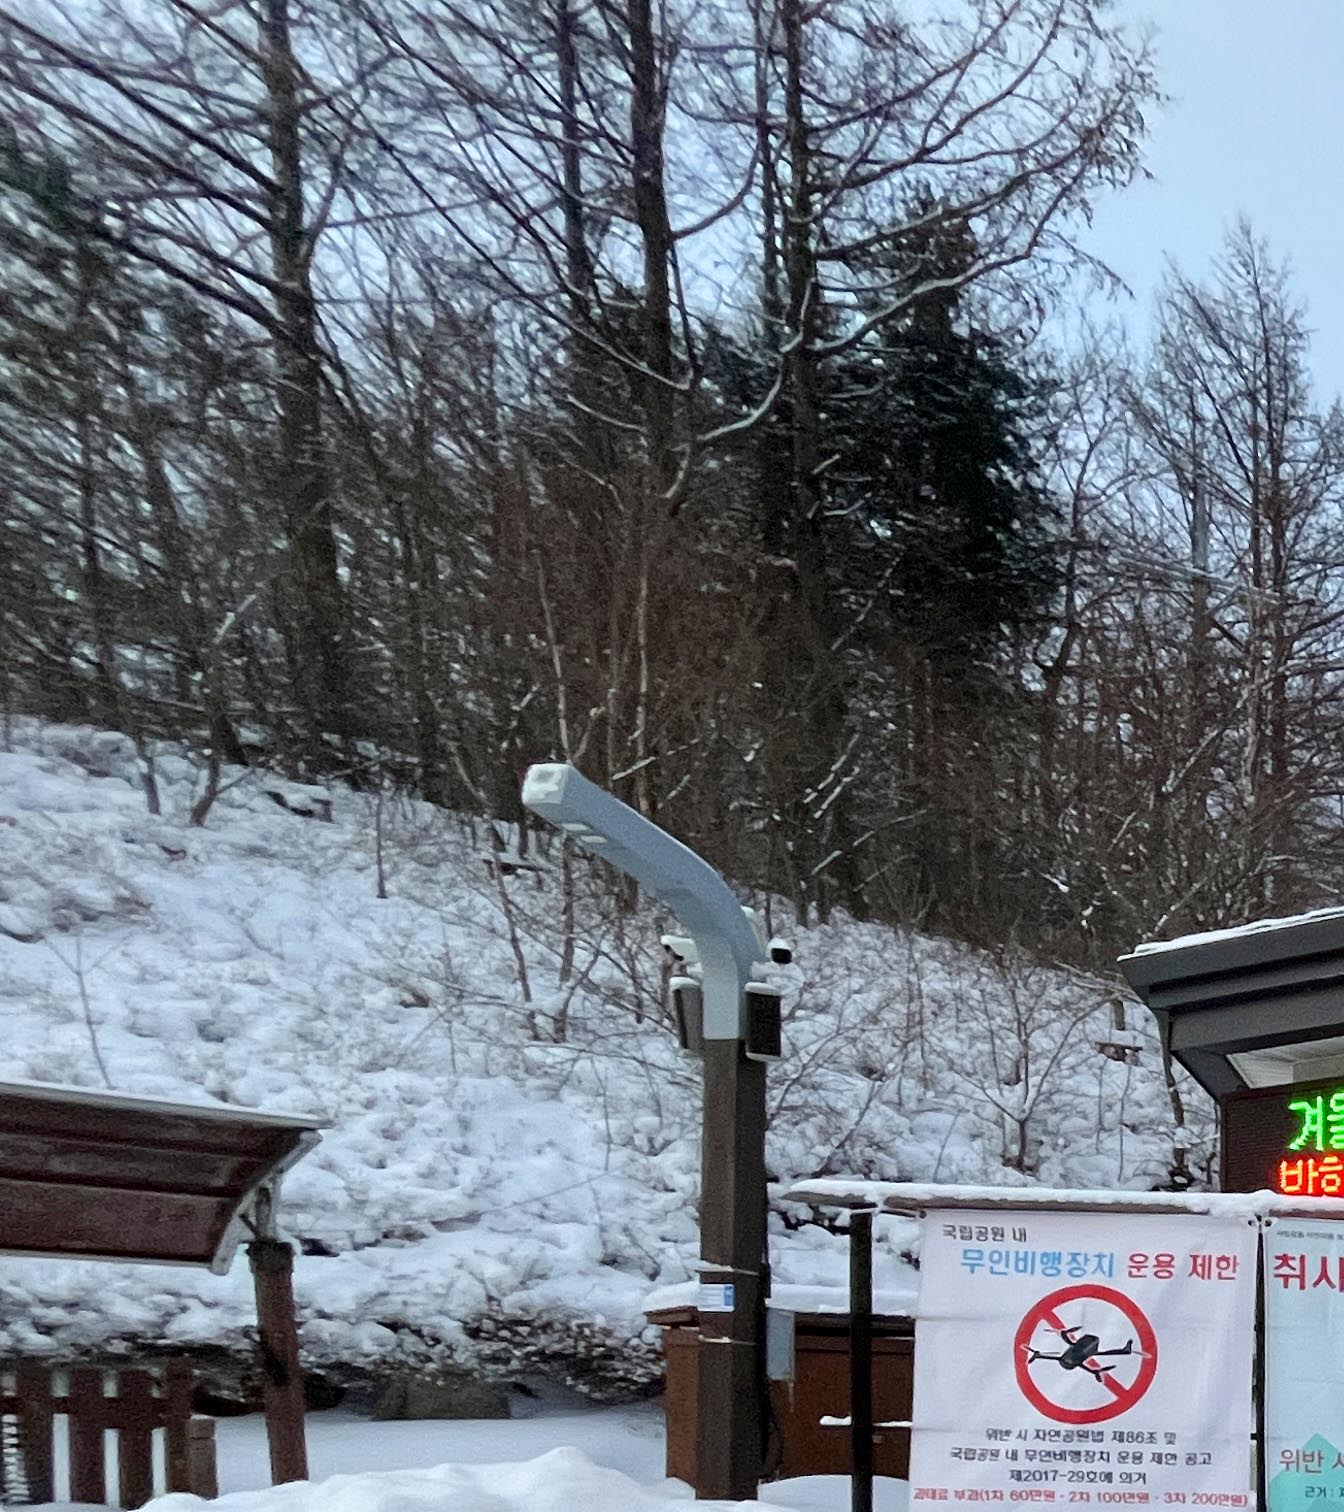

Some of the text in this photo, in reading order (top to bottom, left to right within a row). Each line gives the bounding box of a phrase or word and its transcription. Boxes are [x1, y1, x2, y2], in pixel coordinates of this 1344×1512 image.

[942, 1224, 1027, 1242] 국립공원 내
[961, 1249, 1240, 1280] 무인비행장치 운용 제한
[985, 1428, 1176, 1445] 위반 시 자연공원법 제86조 및
[951, 1447, 1000, 1461] 국립공원
[1005, 1449, 1019, 1462] 내
[1025, 1450, 1111, 1463] 무인비행장치
[1117, 1451, 1144, 1465] 운용
[1185, 1453, 1212, 1465] 공고
[1279, 1449, 1325, 1473] 위반
[1009, 1469, 1147, 1485] 제2017-29호에 의거
[913, 1488, 948, 1500] 과태료
[1010, 1489, 1056, 1502] 60만원
[1068, 1491, 1090, 1503] 2차
[1098, 1492, 1150, 1504] 100만원
[1163, 1492, 1186, 1504] 3차
[1304, 1486, 1327, 1498] 근거
